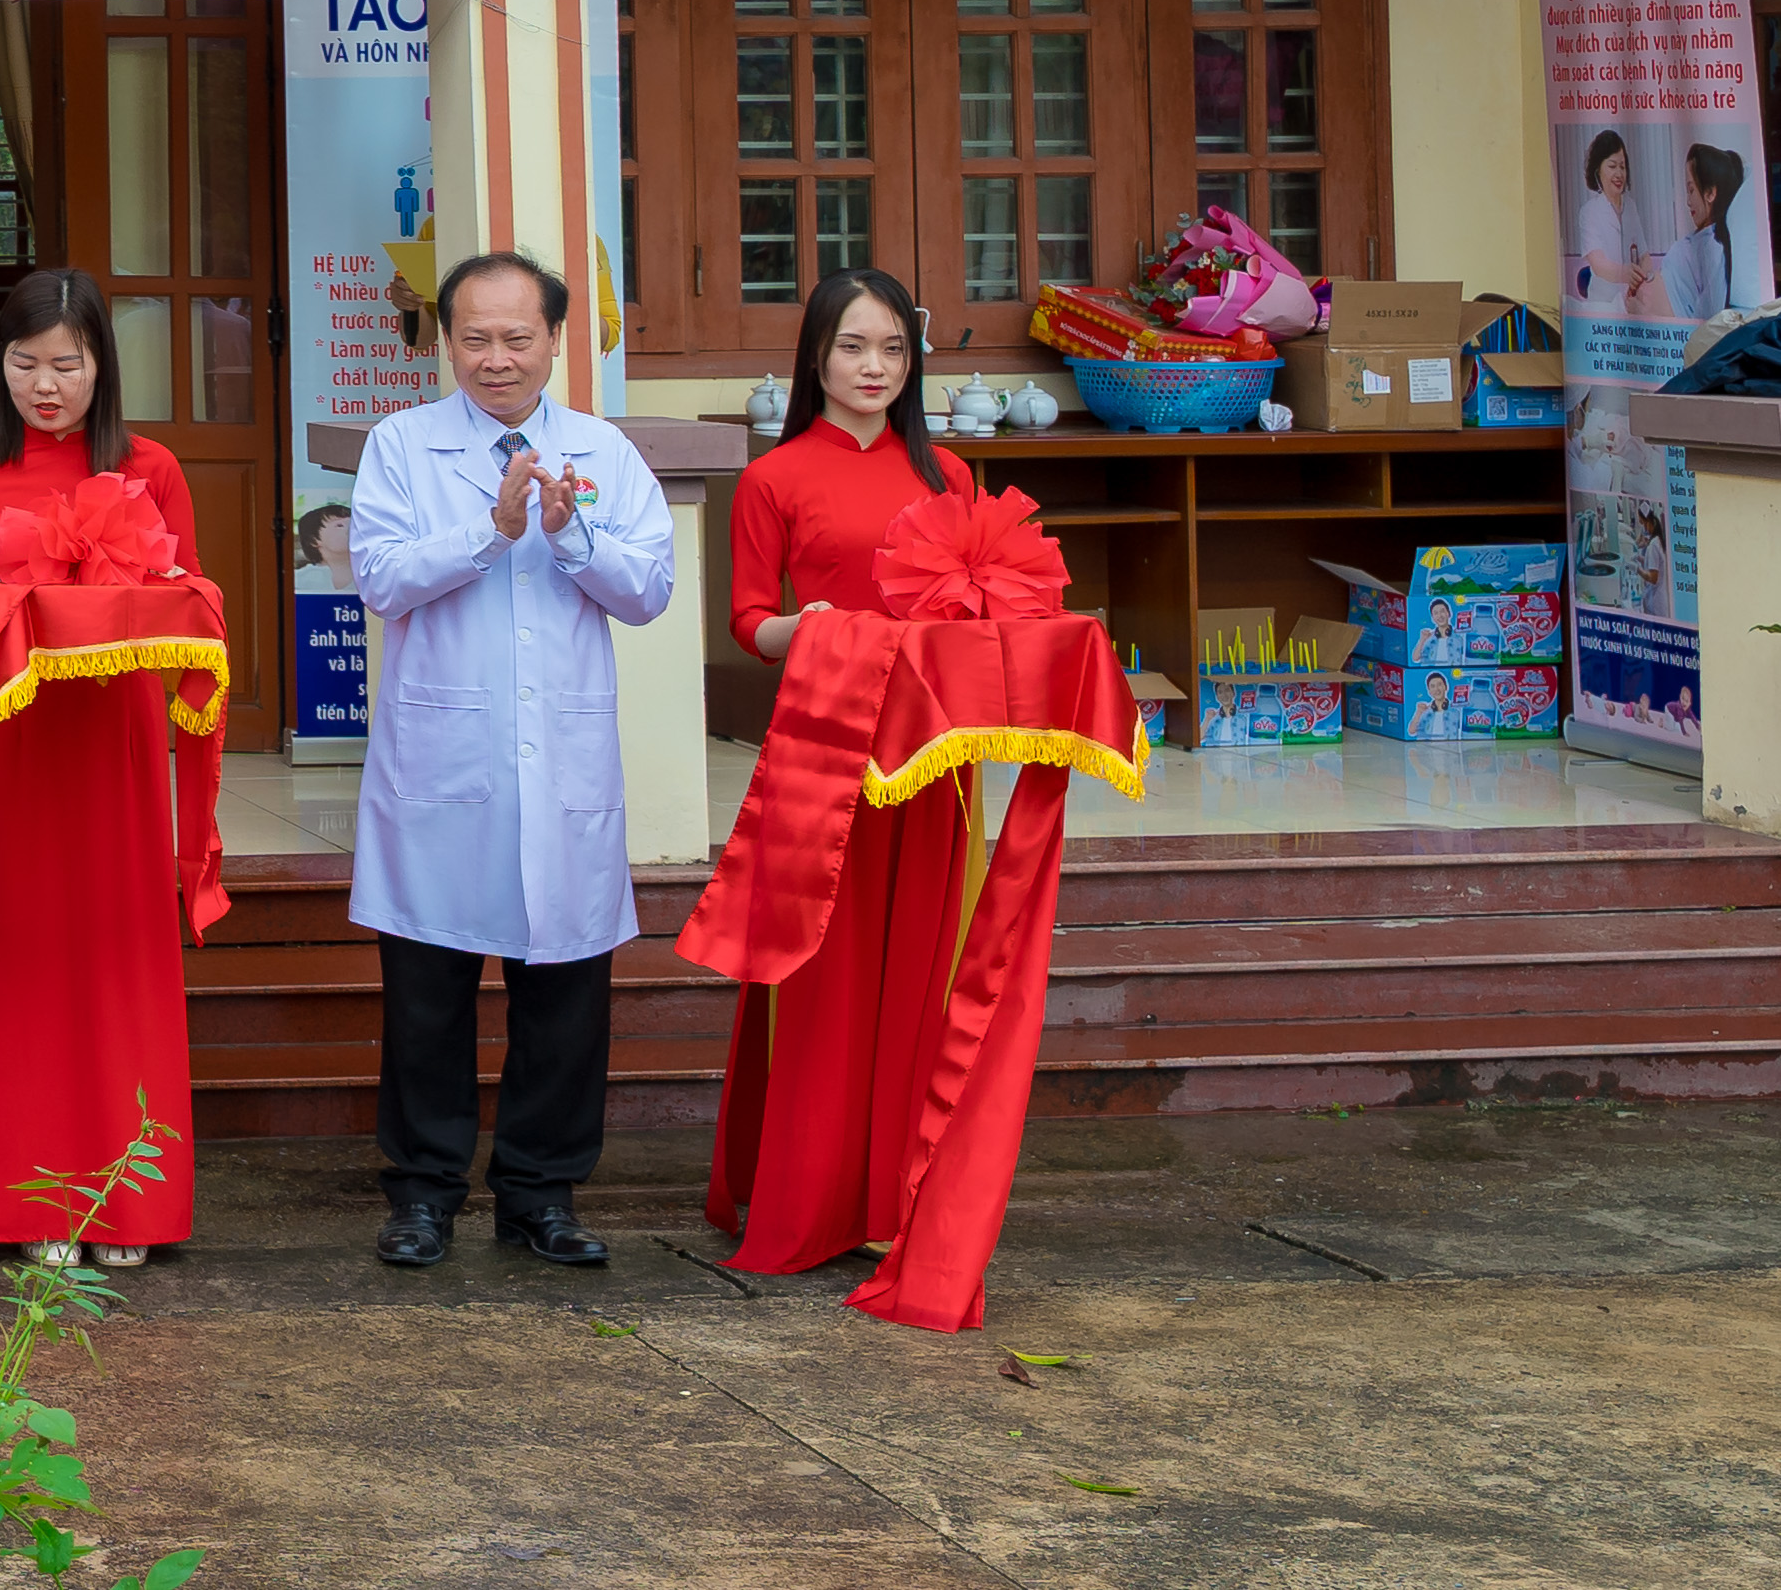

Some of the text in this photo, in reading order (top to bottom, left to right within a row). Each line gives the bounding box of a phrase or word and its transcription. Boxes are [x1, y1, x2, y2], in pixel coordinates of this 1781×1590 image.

[1589, 0, 1741, 27] nhiều gia đình quan tâm.
[321, 38, 397, 62] VÀ HÔN
[313, 253, 374, 276] HỆ LỤY:
[329, 282, 378, 300] Nhiều
[331, 312, 374, 329] trước
[330, 340, 365, 357] Làm
[370, 344, 397, 361] suy
[332, 367, 420, 390] chất lượng
[332, 396, 365, 414] Làm
[328, 654, 364, 671] và là
[316, 703, 345, 720] tiến
